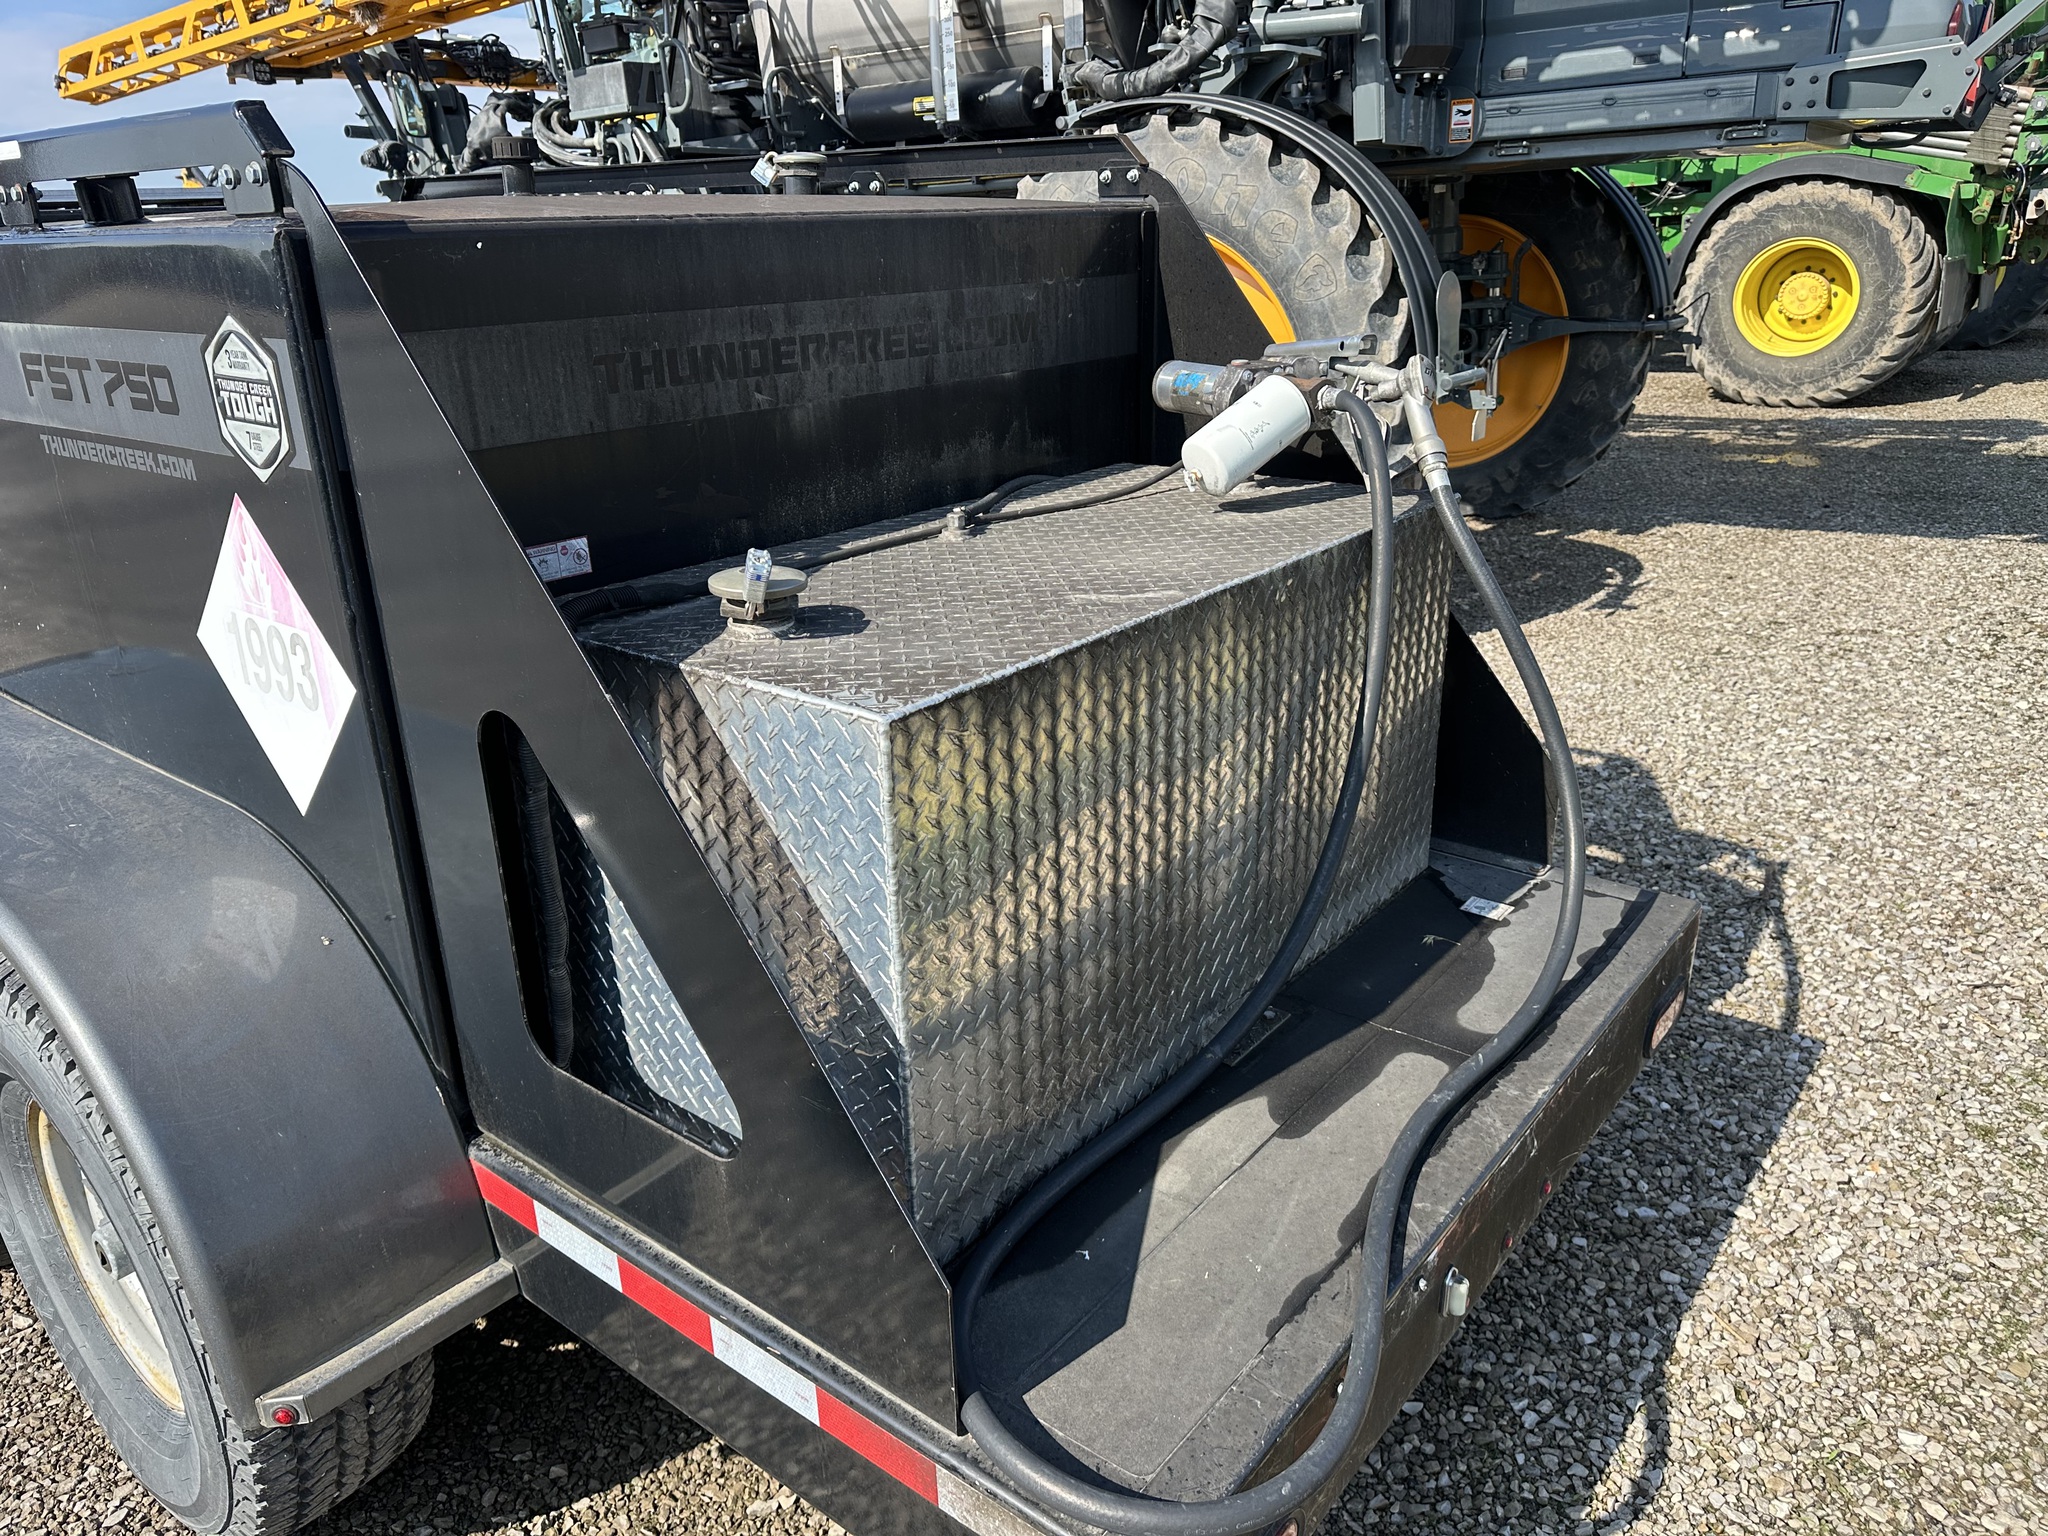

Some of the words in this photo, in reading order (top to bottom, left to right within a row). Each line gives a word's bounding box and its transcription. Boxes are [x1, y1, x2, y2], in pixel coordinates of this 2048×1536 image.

[224, 349, 233, 369] 3
[20, 352, 91, 404] FST
[96, 359, 180, 416] 750
[217, 378, 248, 394] THUNDER
[249, 384, 272, 397] CREEK
[220, 391, 278, 425] TOUGH
[246, 431, 252, 450] 7
[40, 434, 197, 482] THUNDERCREEK.COM
[226, 611, 320, 712] 1993
